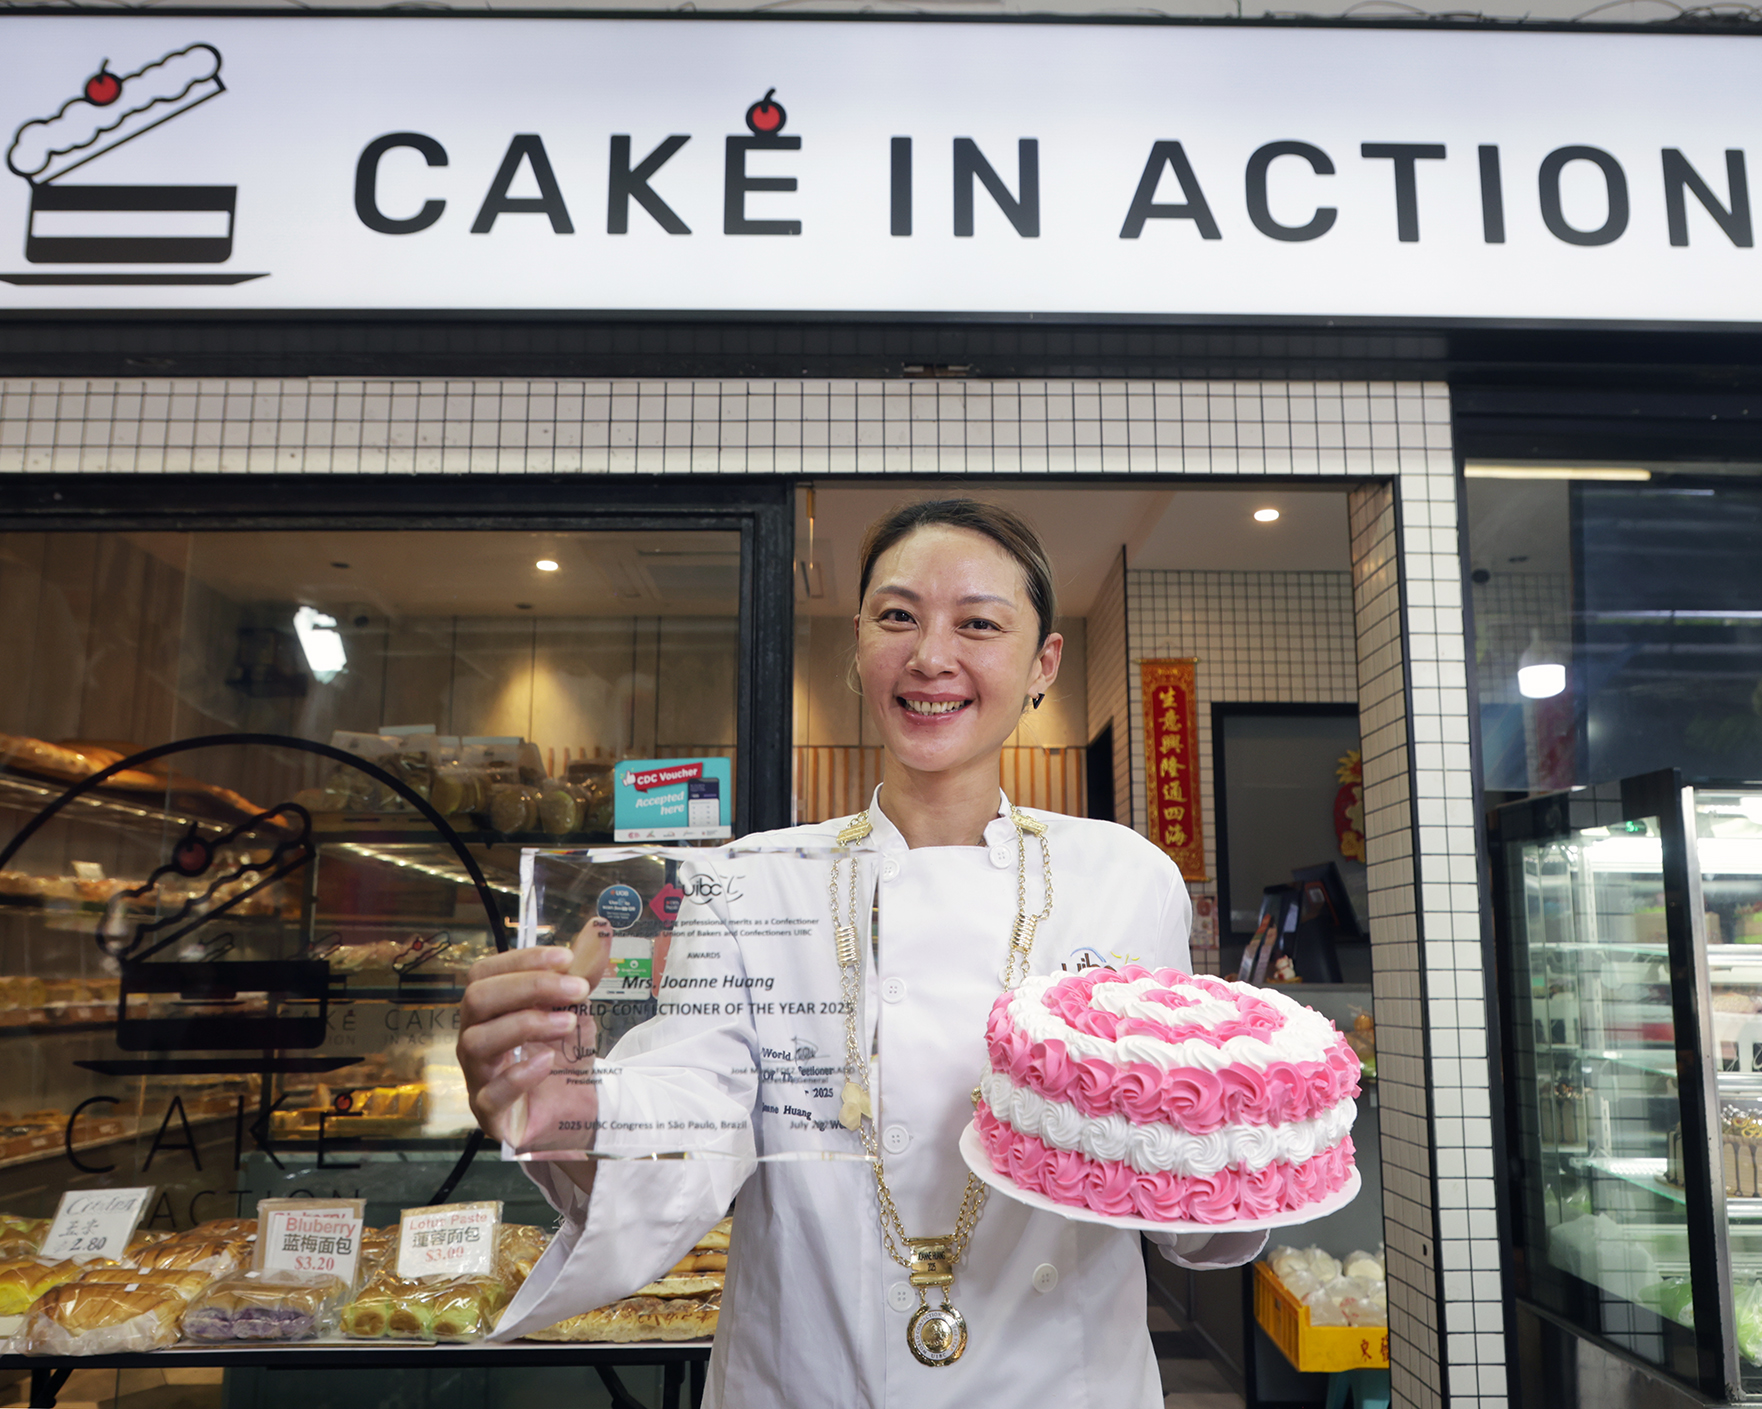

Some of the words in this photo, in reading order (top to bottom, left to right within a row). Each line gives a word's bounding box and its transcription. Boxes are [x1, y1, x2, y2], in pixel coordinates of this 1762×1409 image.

[353, 131, 802, 236] CAKE
[889, 136, 1041, 239] IN
[1118, 139, 1755, 249] ACTION
[636, 773, 658, 786] CDC
[659, 767, 698, 782] Voucher
[635, 791, 685, 809] Accepted
[660, 804, 685, 816] here
[680, 919, 726, 929] professional
[728, 918, 752, 926] merits
[770, 918, 820, 926] Confectioner
[724, 929, 738, 937] and
[739, 929, 792, 937] Confectioners
[793, 929, 813, 937] UIBC
[686, 951, 721, 960] AWARDS
[621, 975, 657, 990] Mrs.
[660, 975, 717, 990] Joanne
[722, 974, 775, 991] Huang
[612, 1003, 720, 1017] CONFECTIONER
[724, 1002, 744, 1016] OF
[750, 1002, 775, 1015] THE
[779, 1002, 815, 1015] YEAR
[820, 1002, 854, 1015] 2025
[761, 1047, 791, 1061] World
[566, 1077, 603, 1086] President
[812, 1088, 834, 1098] 2025
[783, 1105, 812, 1121] Huang
[65, 1094, 363, 1174] CAKE
[558, 1121, 582, 1131] 2025
[610, 1120, 653, 1133] Congress
[656, 1120, 664, 1130] in
[668, 1120, 685, 1130] São
[687, 1120, 718, 1132] Paulo,
[720, 1120, 747, 1130] Brazil
[790, 1120, 809, 1132] July
[450, 1212, 488, 1226] Paste
[285, 1217, 357, 1238] Bluberry
[281, 1233, 353, 1256] 蓝梅面包
[424, 1245, 465, 1263] $3.00
[294, 1255, 336, 1272] $3.20
